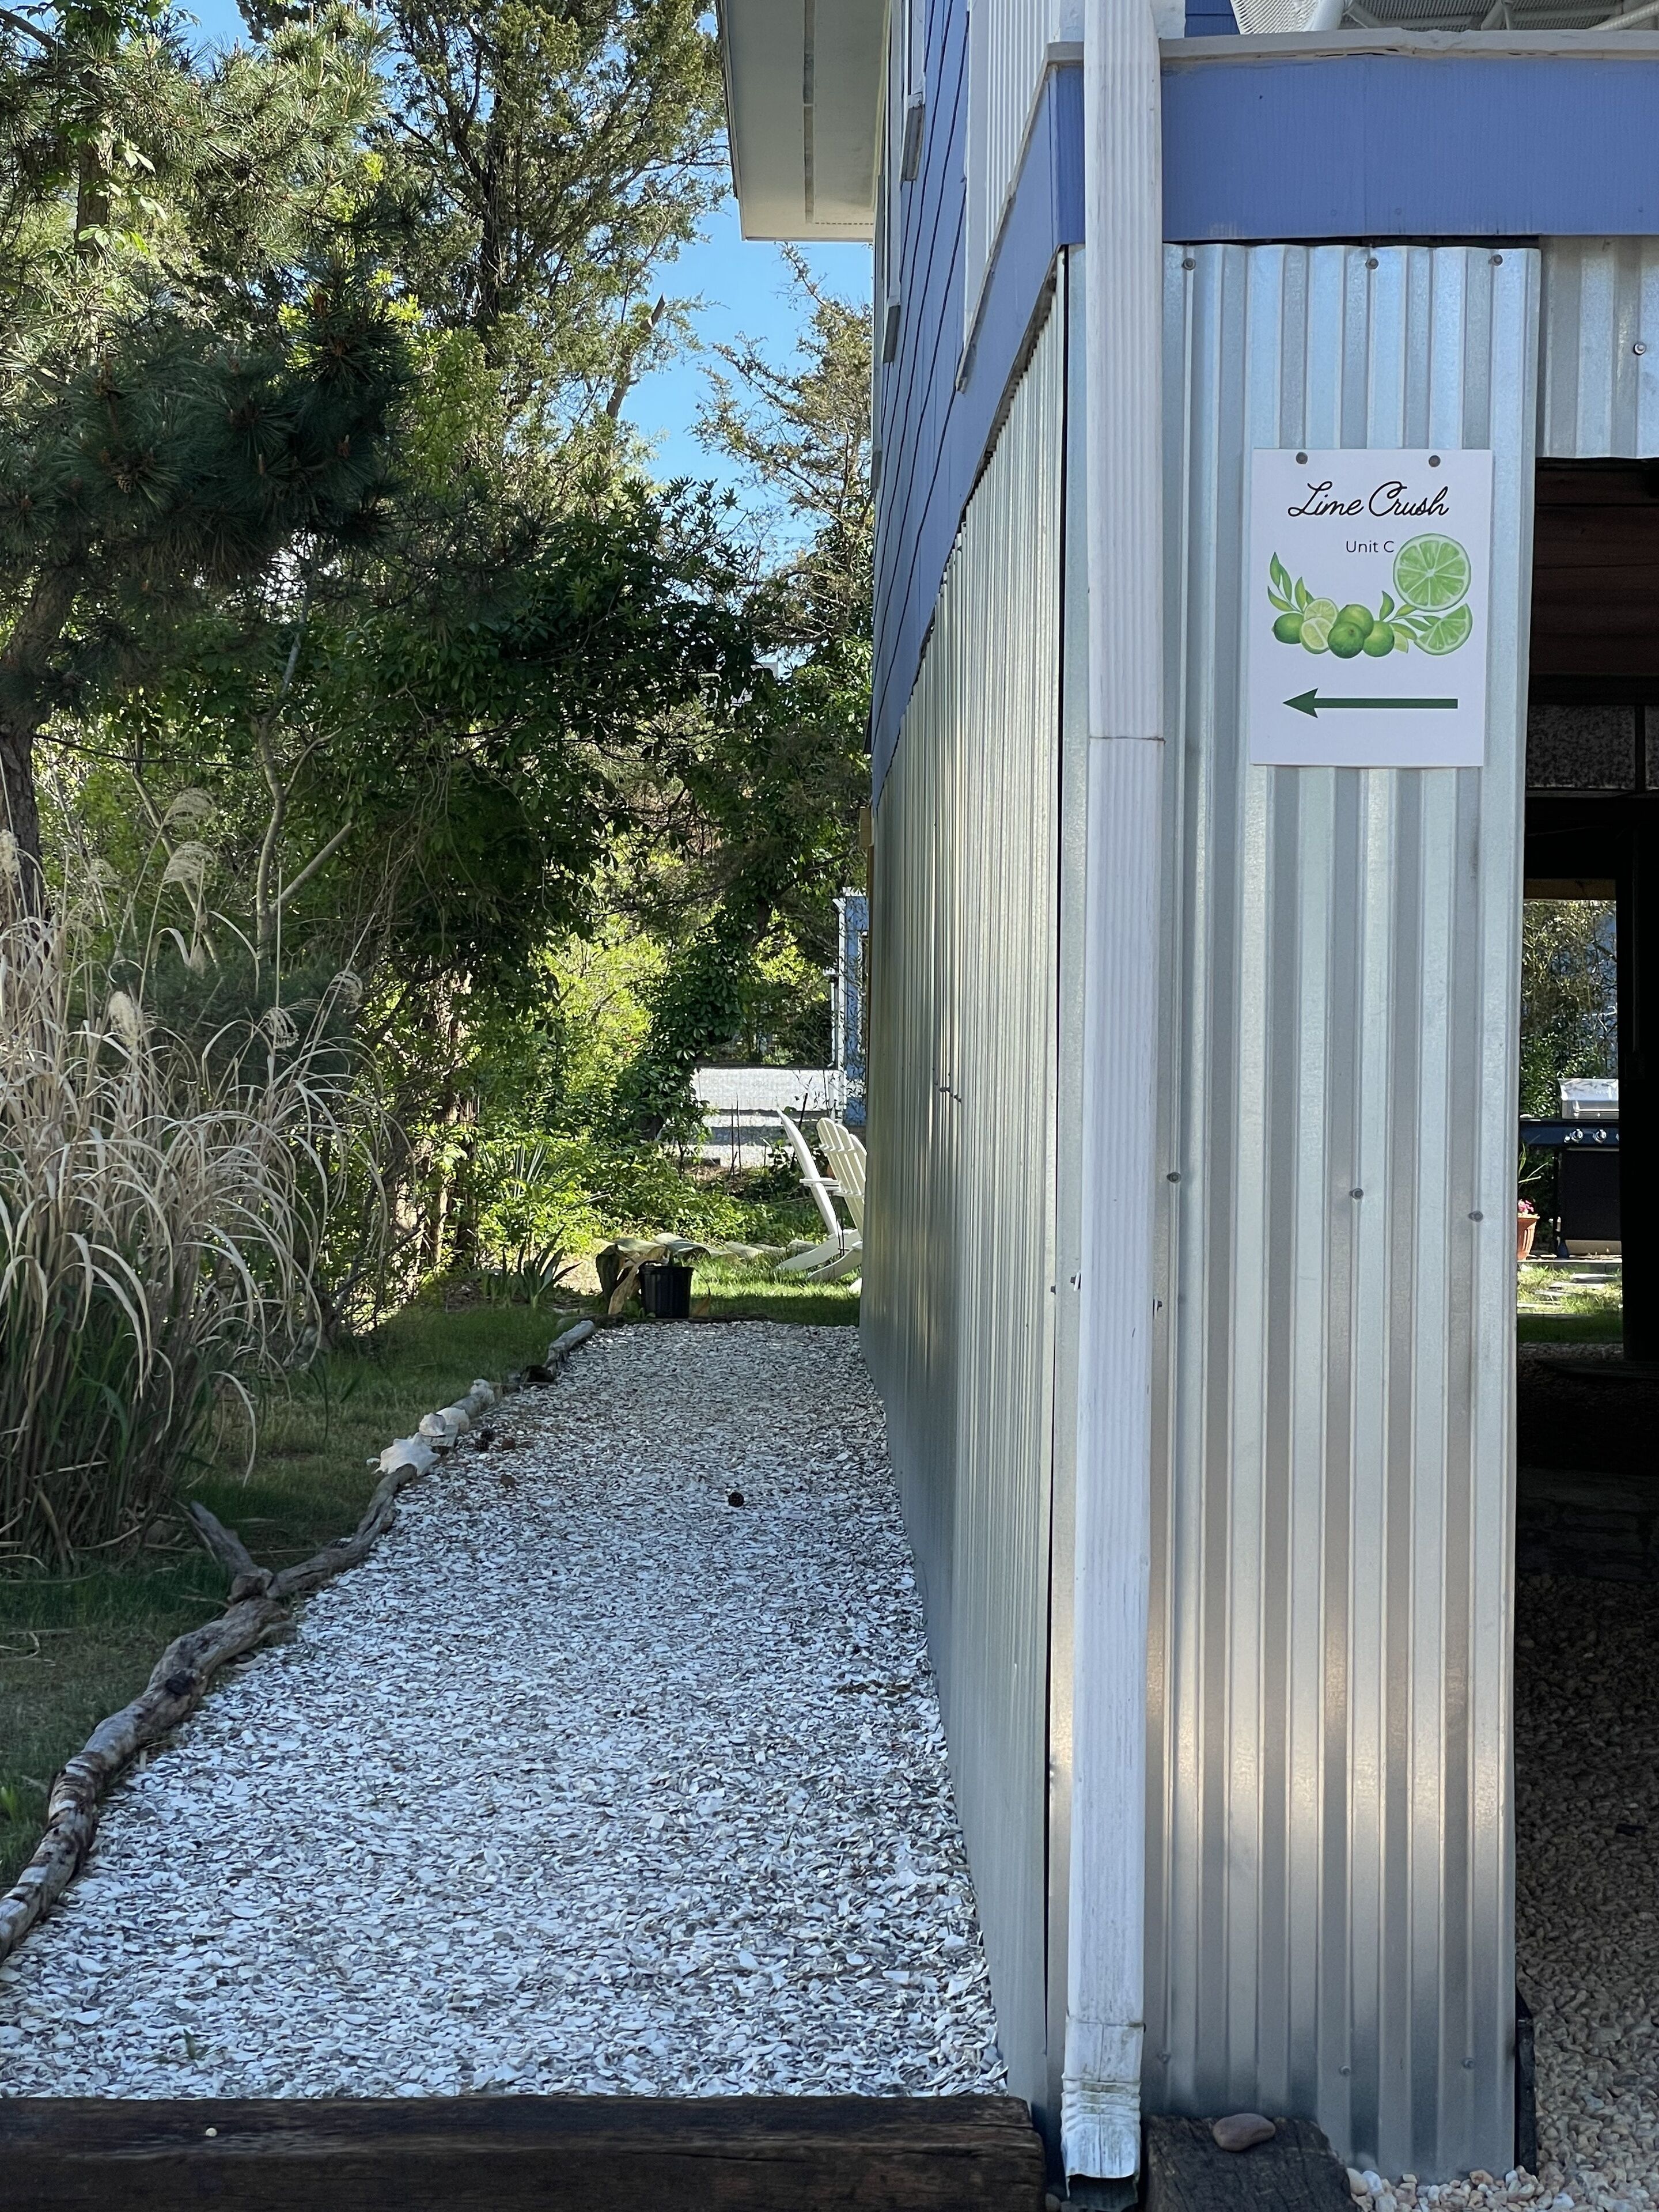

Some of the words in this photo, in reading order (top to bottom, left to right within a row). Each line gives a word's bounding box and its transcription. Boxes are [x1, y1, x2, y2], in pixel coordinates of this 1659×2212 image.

[1287, 480, 1365, 517] Lime
[1368, 480, 1449, 517] Crush
[1346, 540, 1378, 553] Unit
[1383, 540, 1395, 553] C
